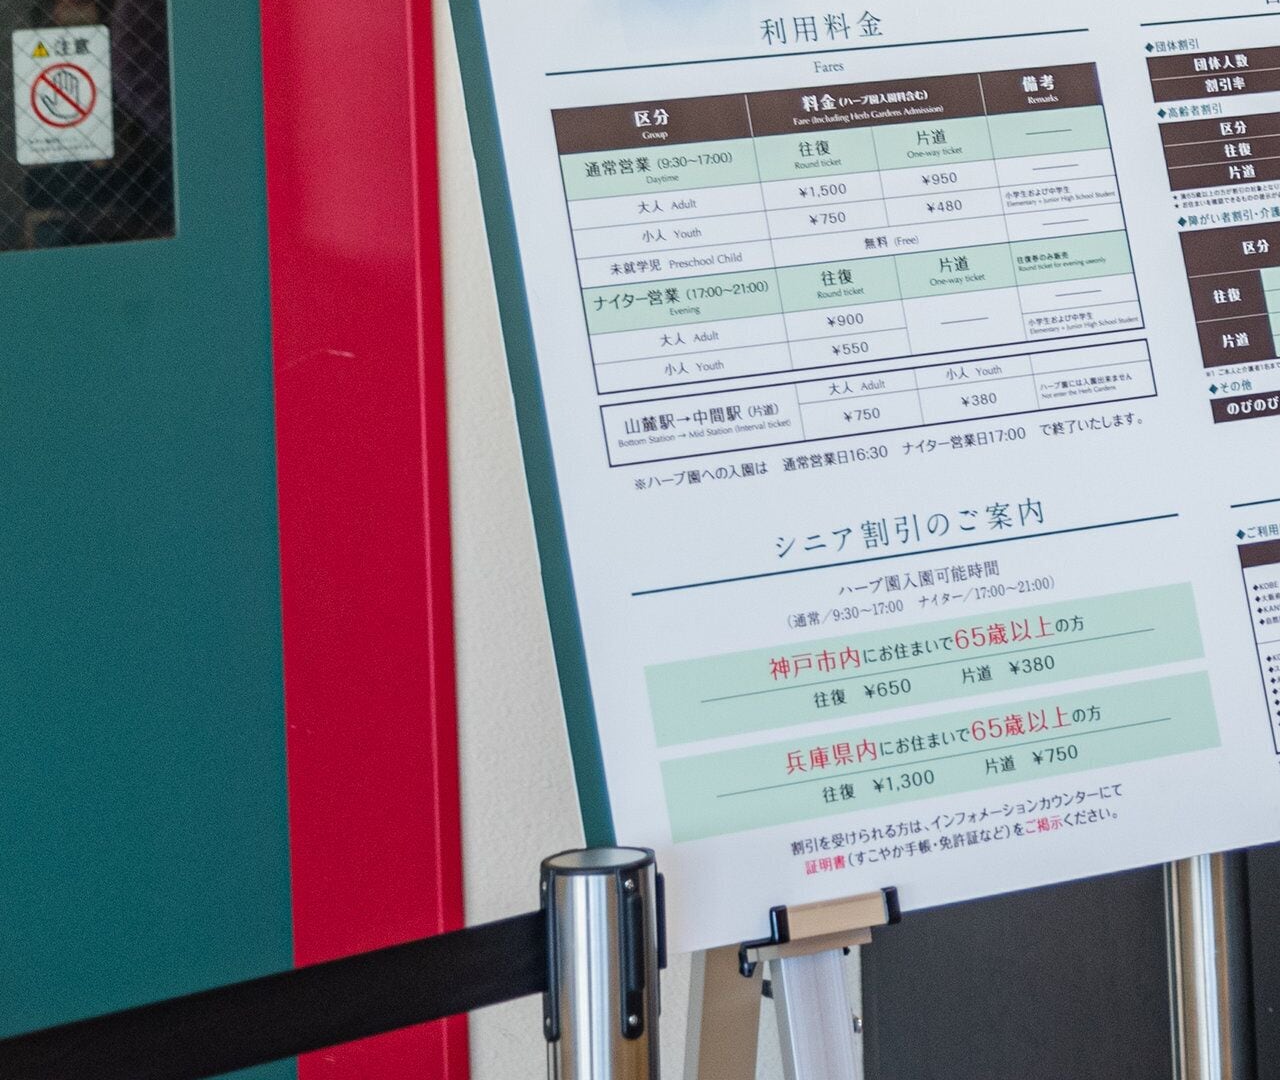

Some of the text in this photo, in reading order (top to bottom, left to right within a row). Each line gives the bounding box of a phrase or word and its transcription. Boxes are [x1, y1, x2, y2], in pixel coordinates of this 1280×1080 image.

[760, 9, 883, 46] 利用料金
[1154, 38, 1199, 53] 団体割引
[813, 60, 844, 73] Fares
[1193, 53, 1249, 72] 団体人数
[1021, 74, 1054, 92] 備考
[1204, 75, 1245, 93] 割引率
[801, 93, 837, 112] 料金
[1167, 102, 1222, 119] 高齢者割引
[633, 108, 670, 127] 区分
[641, 130, 669, 140] Group
[916, 128, 947, 145] 片道
[1219, 120, 1247, 136] 区分
[798, 139, 831, 157] 往復
[1223, 142, 1252, 158] 往復
[584, 156, 651, 177] 通常営業
[1228, 163, 1256, 179] 片道
[645, 174, 679, 185] Daytime
[921, 171, 958, 186] ¥950
[798, 182, 847, 198] ¥1,500
[637, 198, 697, 214] 大人 Adult
[926, 198, 963, 213] ¥480
[808, 211, 846, 226] ¥750
[641, 226, 702, 243] 小人 Youth
[863, 234, 919, 250] 無料 (Free)
[1241, 238, 1269, 255] 区分
[610, 251, 743, 275] 未就学児 Preschool Child
[938, 255, 970, 273] 片道
[820, 268, 854, 287] 往復
[593, 287, 680, 312] ナイター営業
[1212, 287, 1242, 304] 往復
[826, 312, 864, 327] ¥900
[659, 330, 719, 347] 大人 Adult
[1222, 331, 1250, 348] 片道
[831, 340, 869, 356] ¥550
[664, 359, 725, 376] 小人 Youth
[945, 364, 1003, 381] 小人 Youth
[828, 378, 886, 396] 大人 Adult
[1219, 378, 1253, 394] その他
[960, 392, 997, 407] ¥380
[842, 406, 881, 422] ¥750
[634, 411, 1143, 490] ※ハーブ園への入園は 通常営業日16:30 ナイター営業日17:00 で終了いたします。
[775, 497, 1044, 559] シニア割引のご案内
[838, 559, 1000, 595] ハーブ園入園可能時間
[1258, 580, 1279, 590] KOBE
[768, 614, 1084, 681] 神戸市内にお住まいで65歳以上の方
[813, 654, 1055, 709] 往復 ¥650 片道 ¥380
[786, 704, 1101, 775] 兵庫県内にお住まいで65歳以上の方
[822, 744, 1078, 803] 往復 ¥1,300 片道 ¥750
